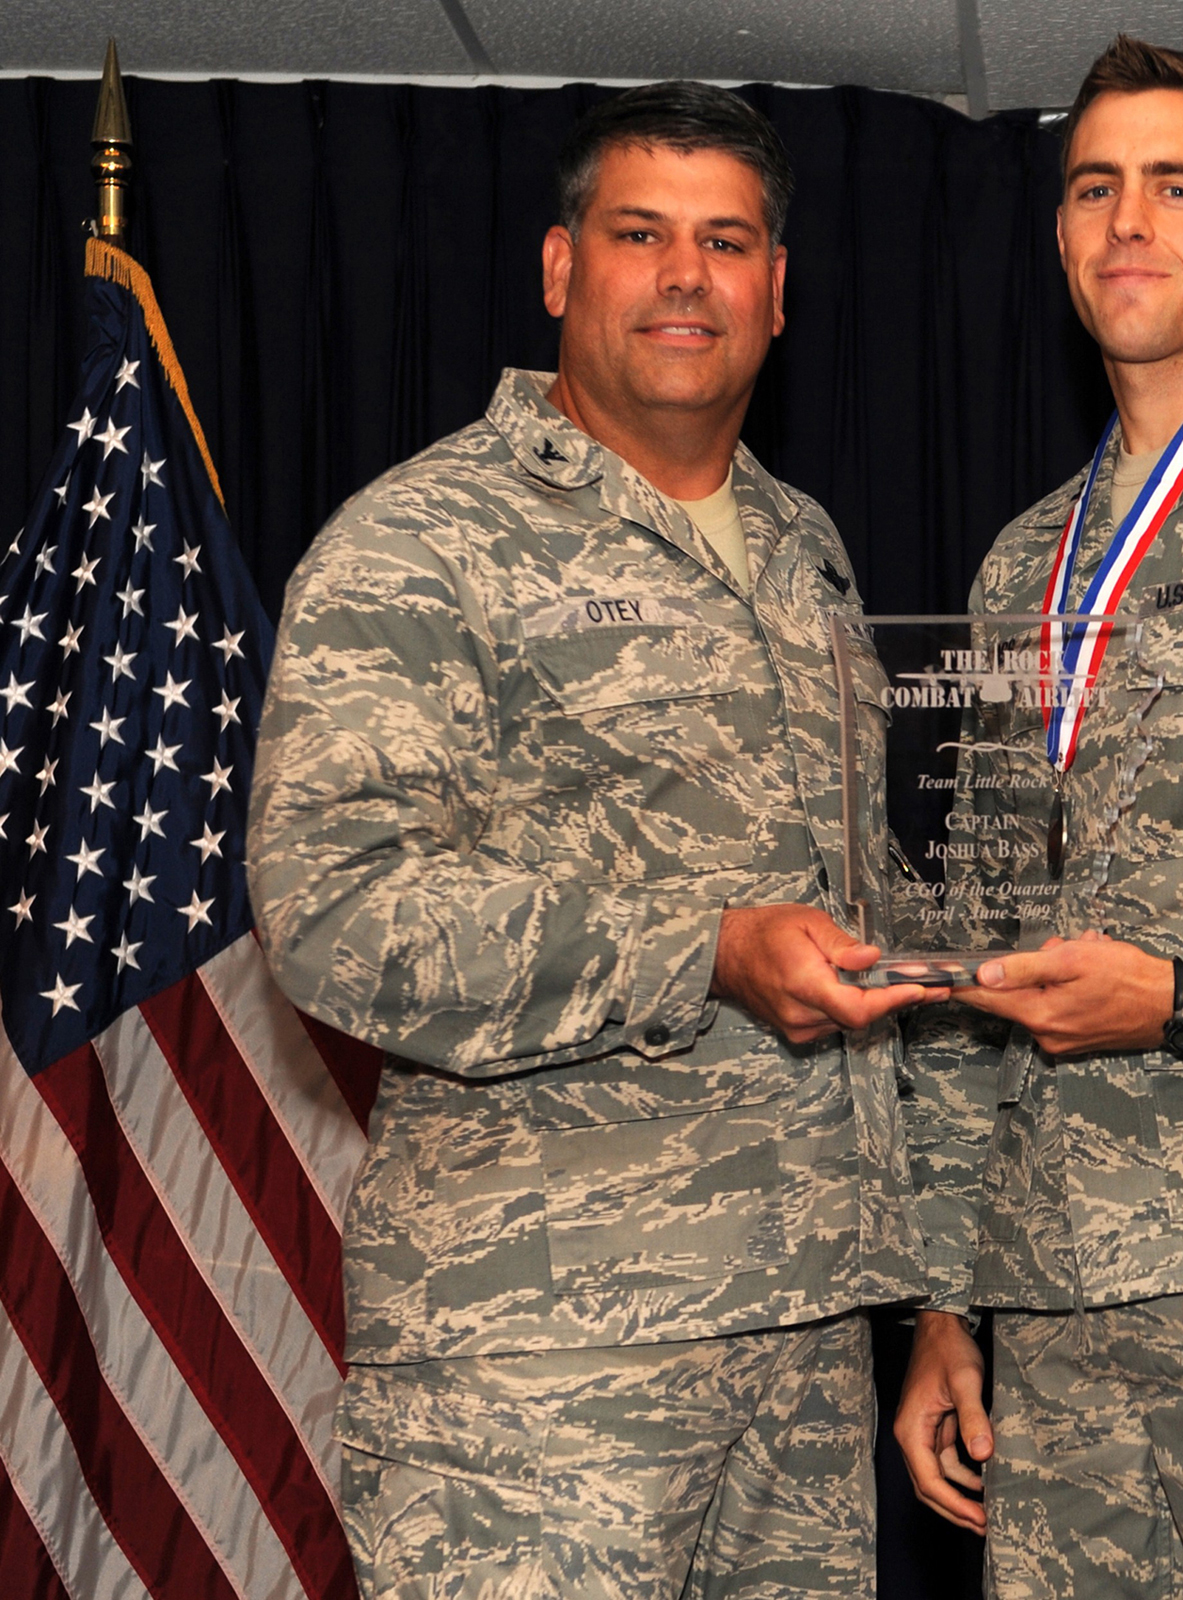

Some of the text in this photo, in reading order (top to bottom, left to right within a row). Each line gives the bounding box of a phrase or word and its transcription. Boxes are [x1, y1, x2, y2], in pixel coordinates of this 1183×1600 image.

[585, 600, 644, 623] OTEY
[940, 649, 989, 671] THE
[1003, 649, 1065, 671] ROCK
[880, 686, 1109, 708] COMBAT AIRLIFT
[917, 774, 1048, 789] Team Little Rock
[998, 840, 1040, 858] BASS
[905, 881, 1061, 900] CGO of the Quarter
[914, 906, 954, 925] April
[969, 905, 1009, 920] June
[1013, 903, 1051, 919] 2009
